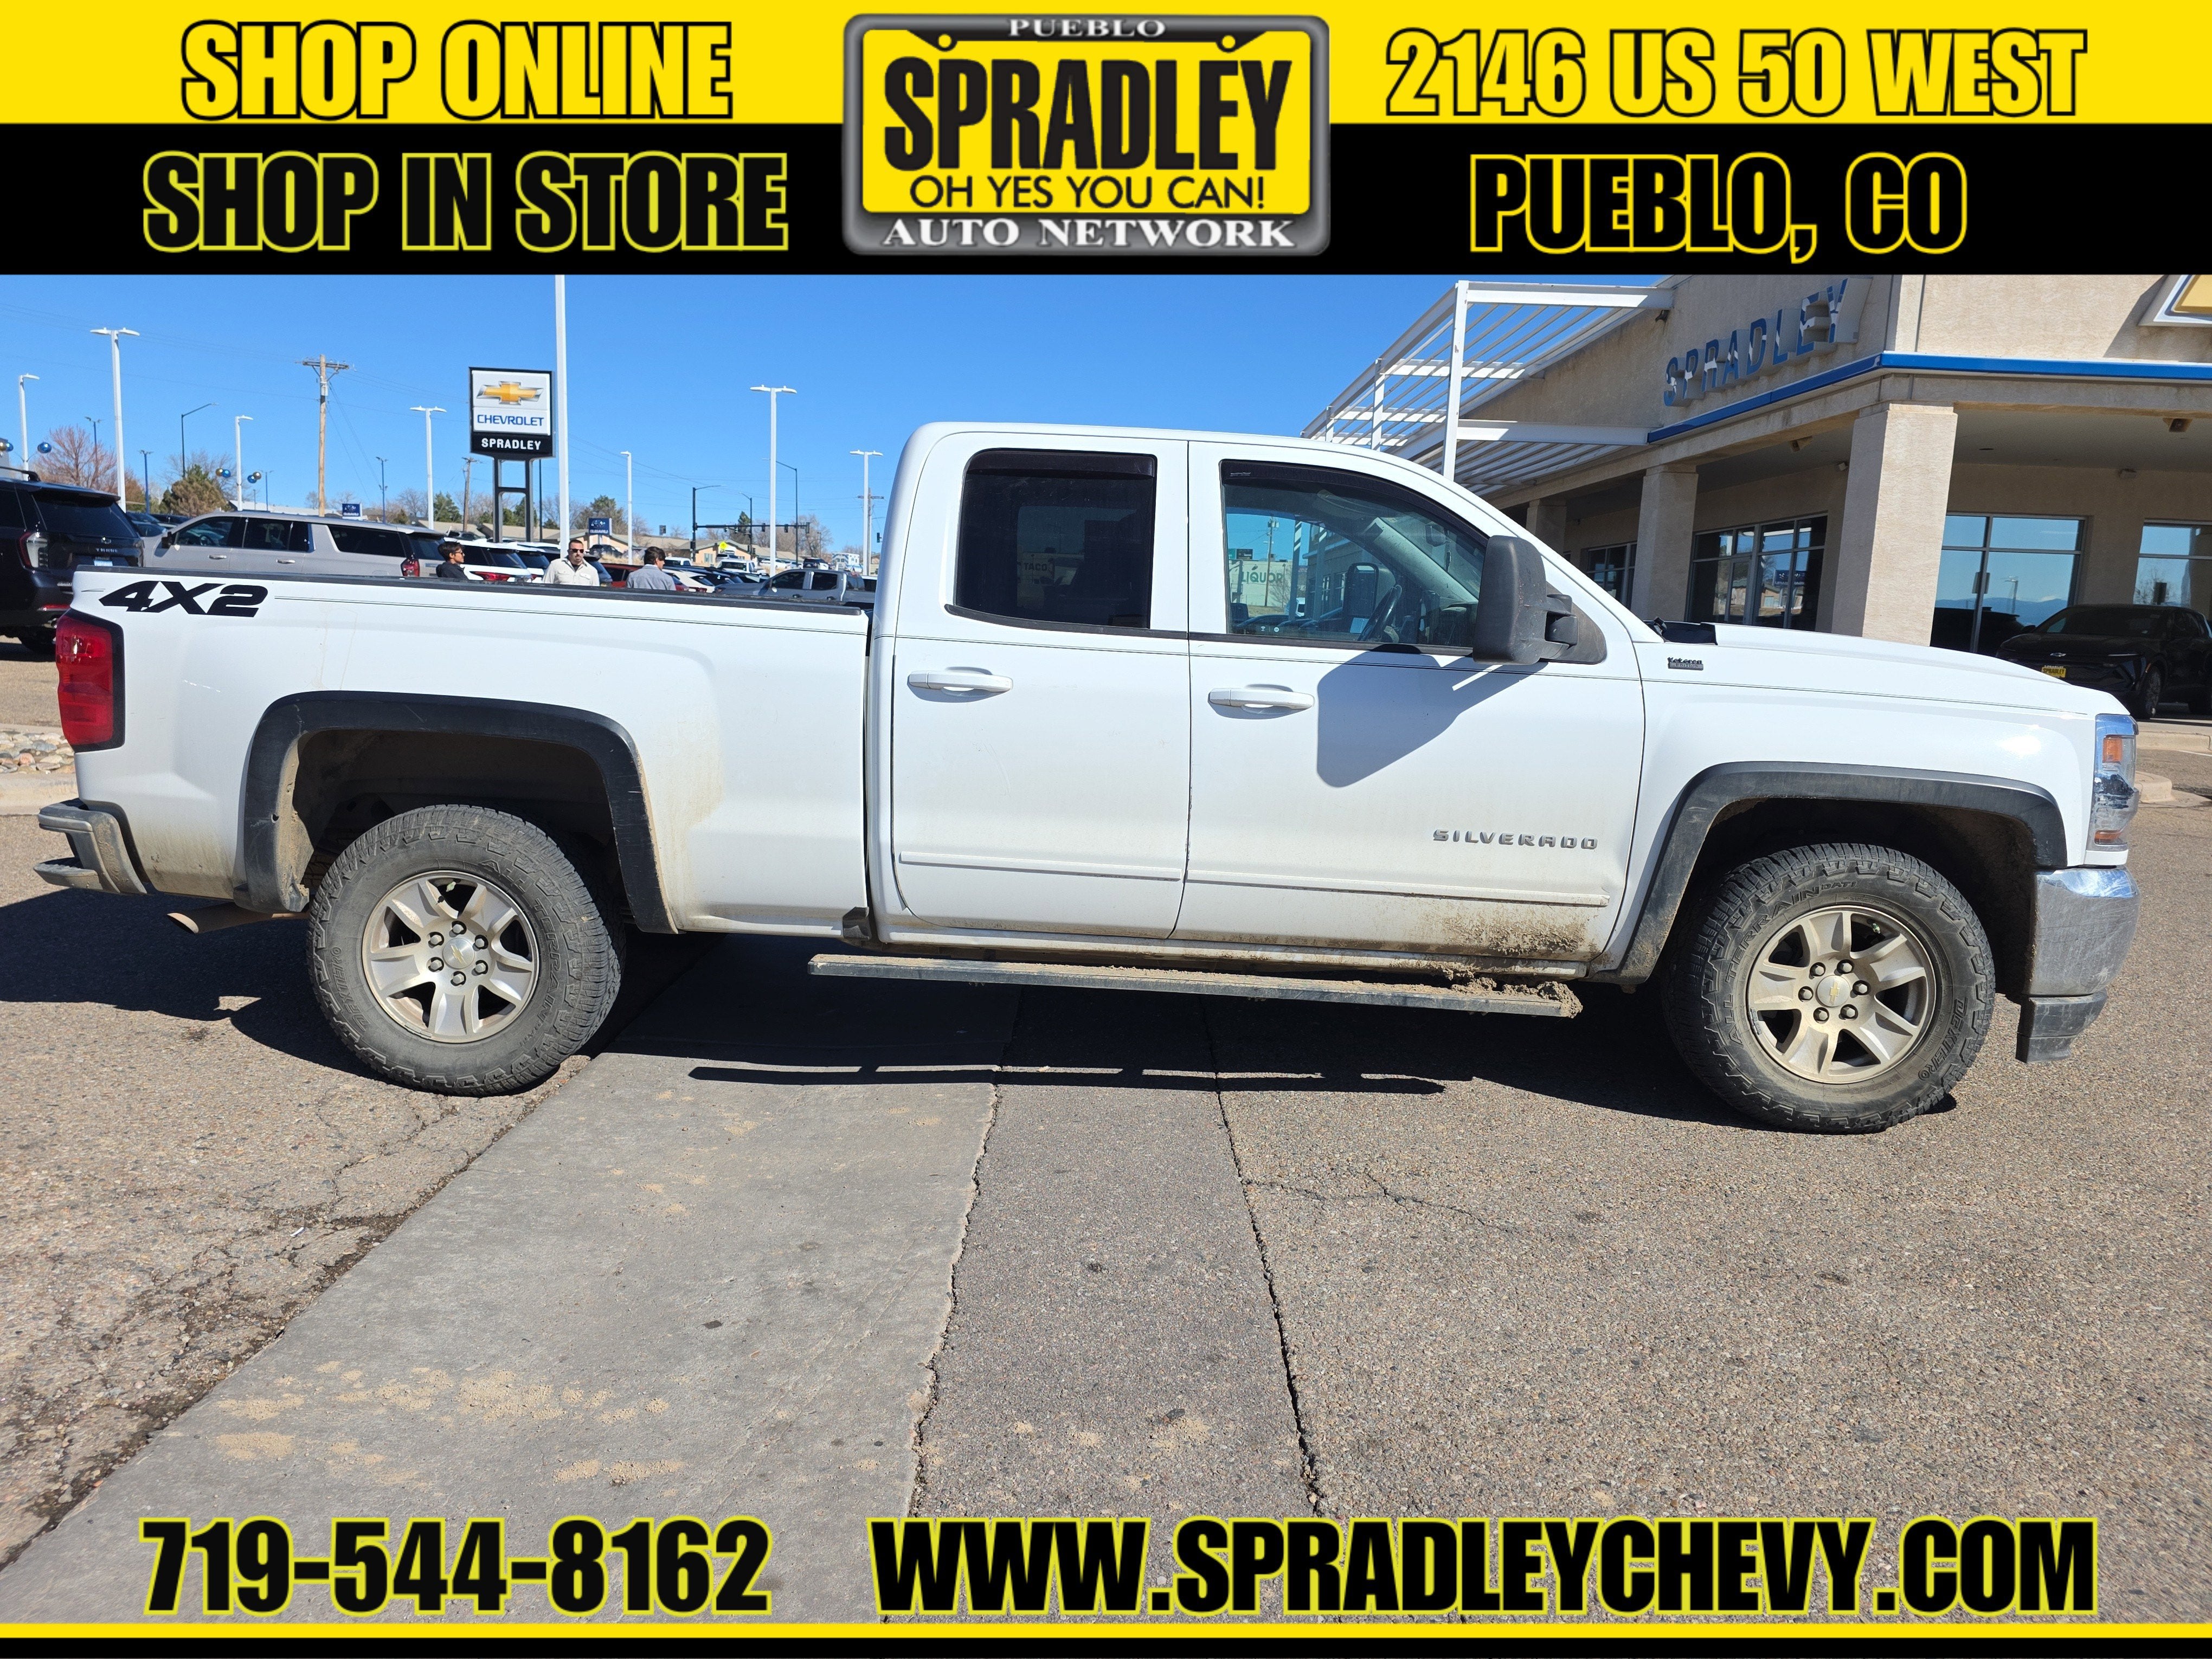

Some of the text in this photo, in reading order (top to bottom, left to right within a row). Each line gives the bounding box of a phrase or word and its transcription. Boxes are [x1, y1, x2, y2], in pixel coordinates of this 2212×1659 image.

[1663, 278, 1851, 407] SPRADLEY
[477, 414, 544, 426] CHEVROLET
[481, 438, 541, 450] SPRADLEY
[1023, 562, 1047, 571] TACO
[1242, 571, 1284, 583] LIQUOR
[98, 580, 268, 618] 4X2
[1433, 829, 1598, 850] SILVERADO
[1725, 886, 1820, 982] TERRAIN
[331, 947, 371, 1032] DEXTERO
[1723, 993, 1744, 1049] ALL
[1918, 996, 1968, 1081] DEXTERO
